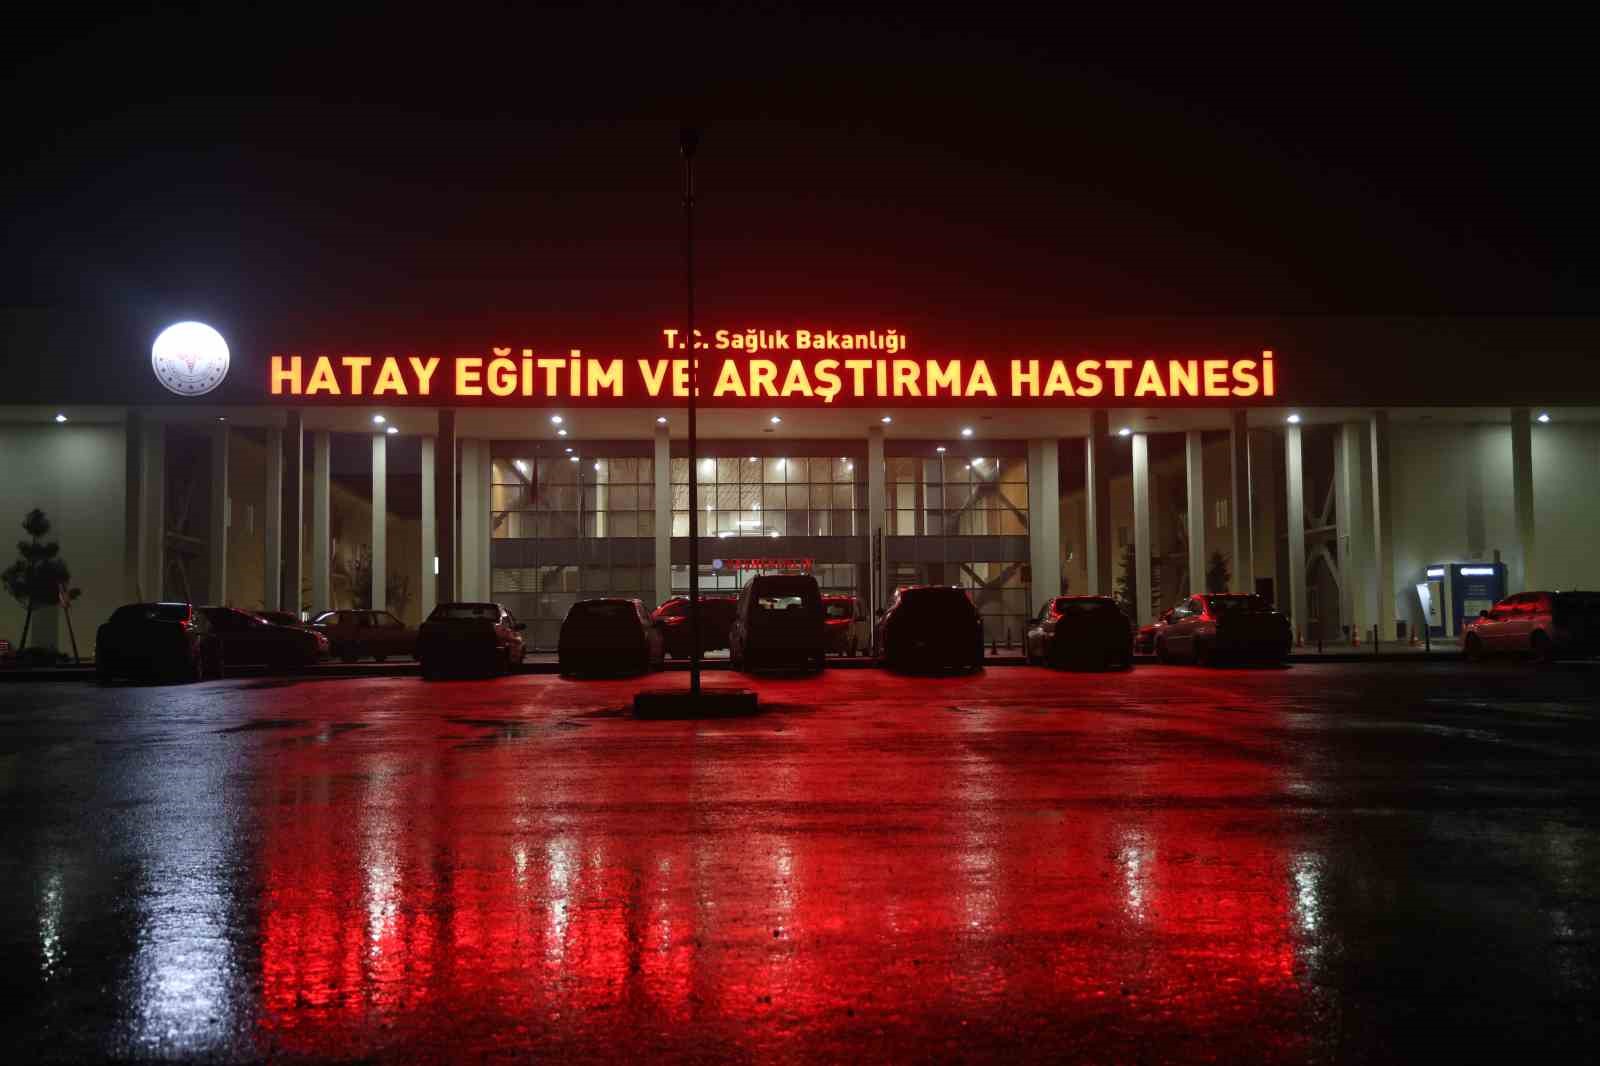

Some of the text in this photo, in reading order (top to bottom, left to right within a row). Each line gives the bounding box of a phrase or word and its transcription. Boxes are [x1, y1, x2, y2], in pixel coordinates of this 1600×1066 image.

[715, 329, 790, 353] Sağlık
[796, 329, 906, 353] Bakanlığı
[271, 347, 1274, 403] HATAY EĞİTİM VE ARAŞTIRMA HASTANESİ
